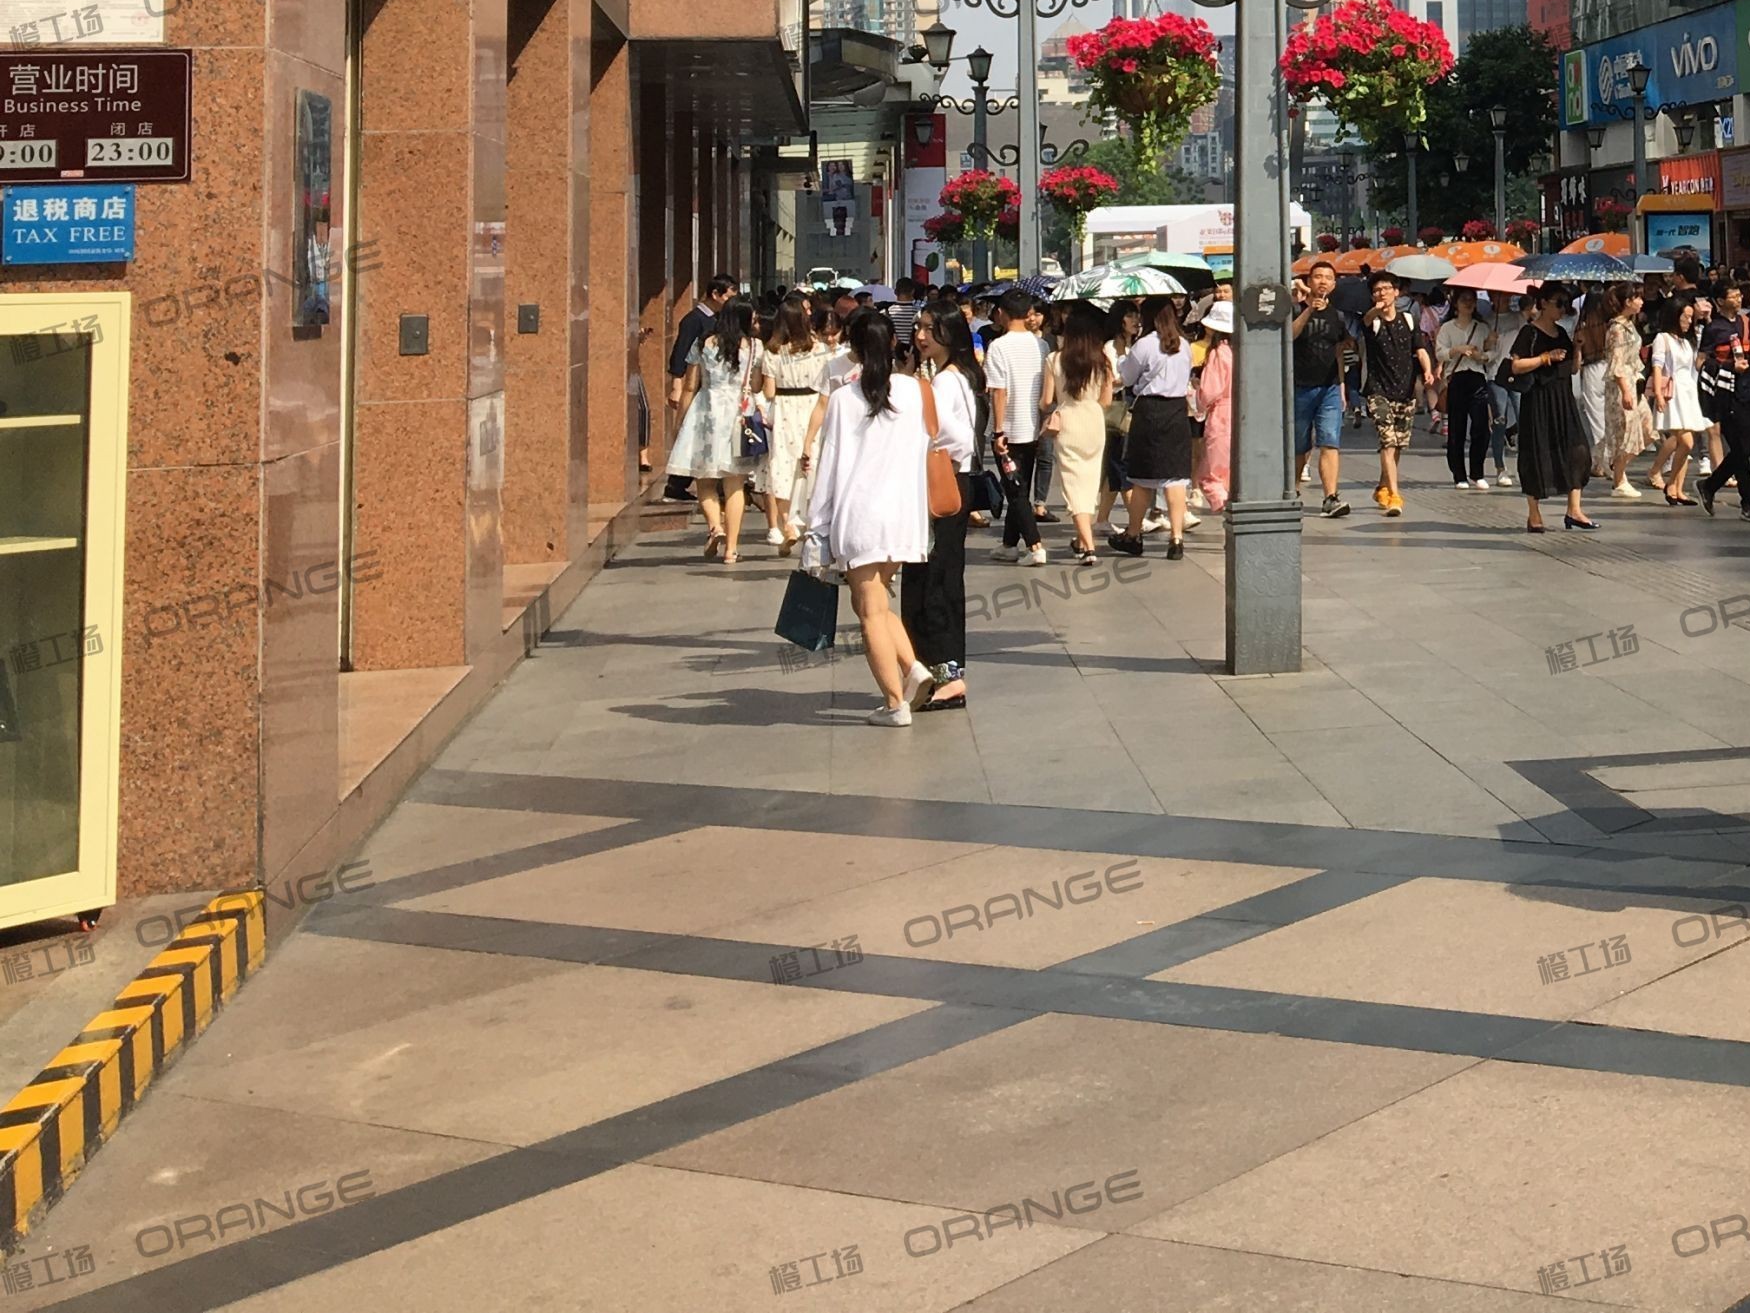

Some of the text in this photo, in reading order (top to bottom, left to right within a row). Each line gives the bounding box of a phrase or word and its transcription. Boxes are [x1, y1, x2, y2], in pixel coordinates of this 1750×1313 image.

[1671, 32, 1718, 78] vivo
[9, 64, 138, 95] 营业时间
[4, 98, 141, 113] Business Time
[91, 142, 170, 162] 23:00
[13, 196, 126, 222] 退税商店
[12, 226, 126, 243] TAX FREE
